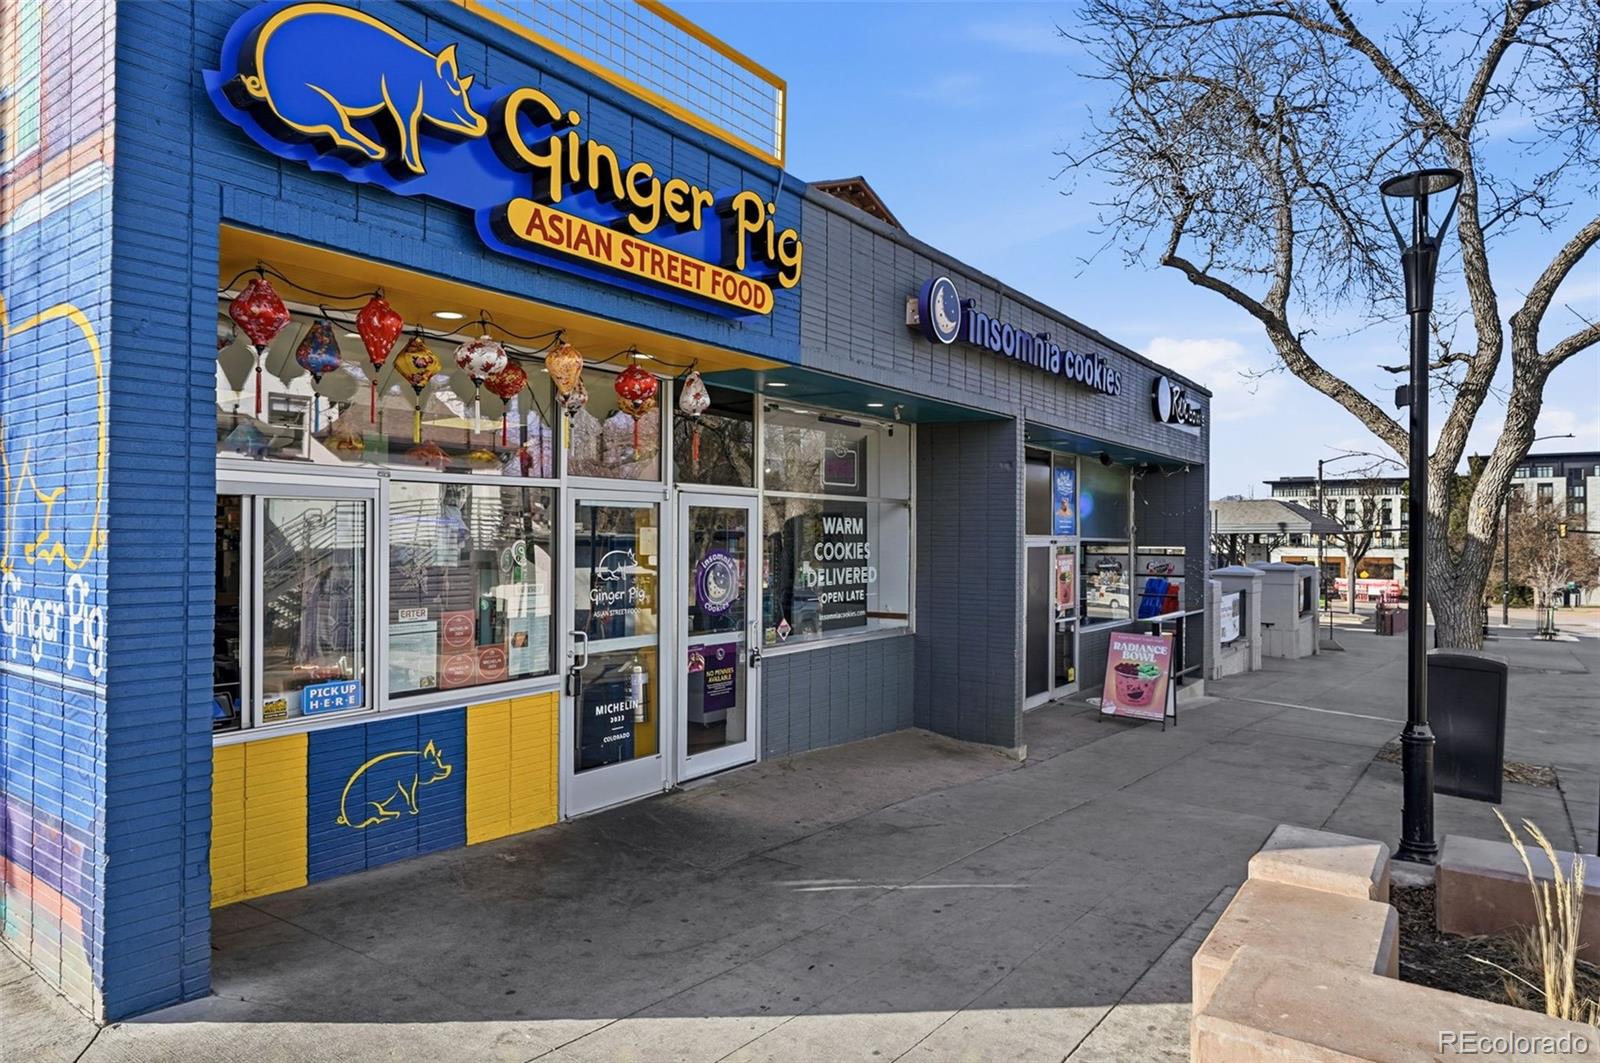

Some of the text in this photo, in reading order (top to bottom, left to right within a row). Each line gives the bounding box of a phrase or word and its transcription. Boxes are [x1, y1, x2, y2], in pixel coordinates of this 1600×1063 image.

[505, 88, 803, 288] Ginger Pig
[525, 208, 765, 309] ASIAN STREET FOOD
[969, 298, 1122, 396] insomnia cookies
[823, 517, 863, 535] WARM
[814, 542, 871, 561] COOKIES
[807, 566, 877, 587] DELIVERED
[590, 587, 645, 606] Ginger Pig
[821, 590, 864, 604] OPEN LATE
[400, 608, 426, 618] EATER
[1, 572, 103, 677] Ginger Pig
[1113, 641, 1168, 655] RADIANCE
[1122, 652, 1157, 663] BOWL
[309, 684, 357, 699] PICK UP
[595, 700, 639, 716] MICHELIN
[603, 732, 630, 743] COLORADO
